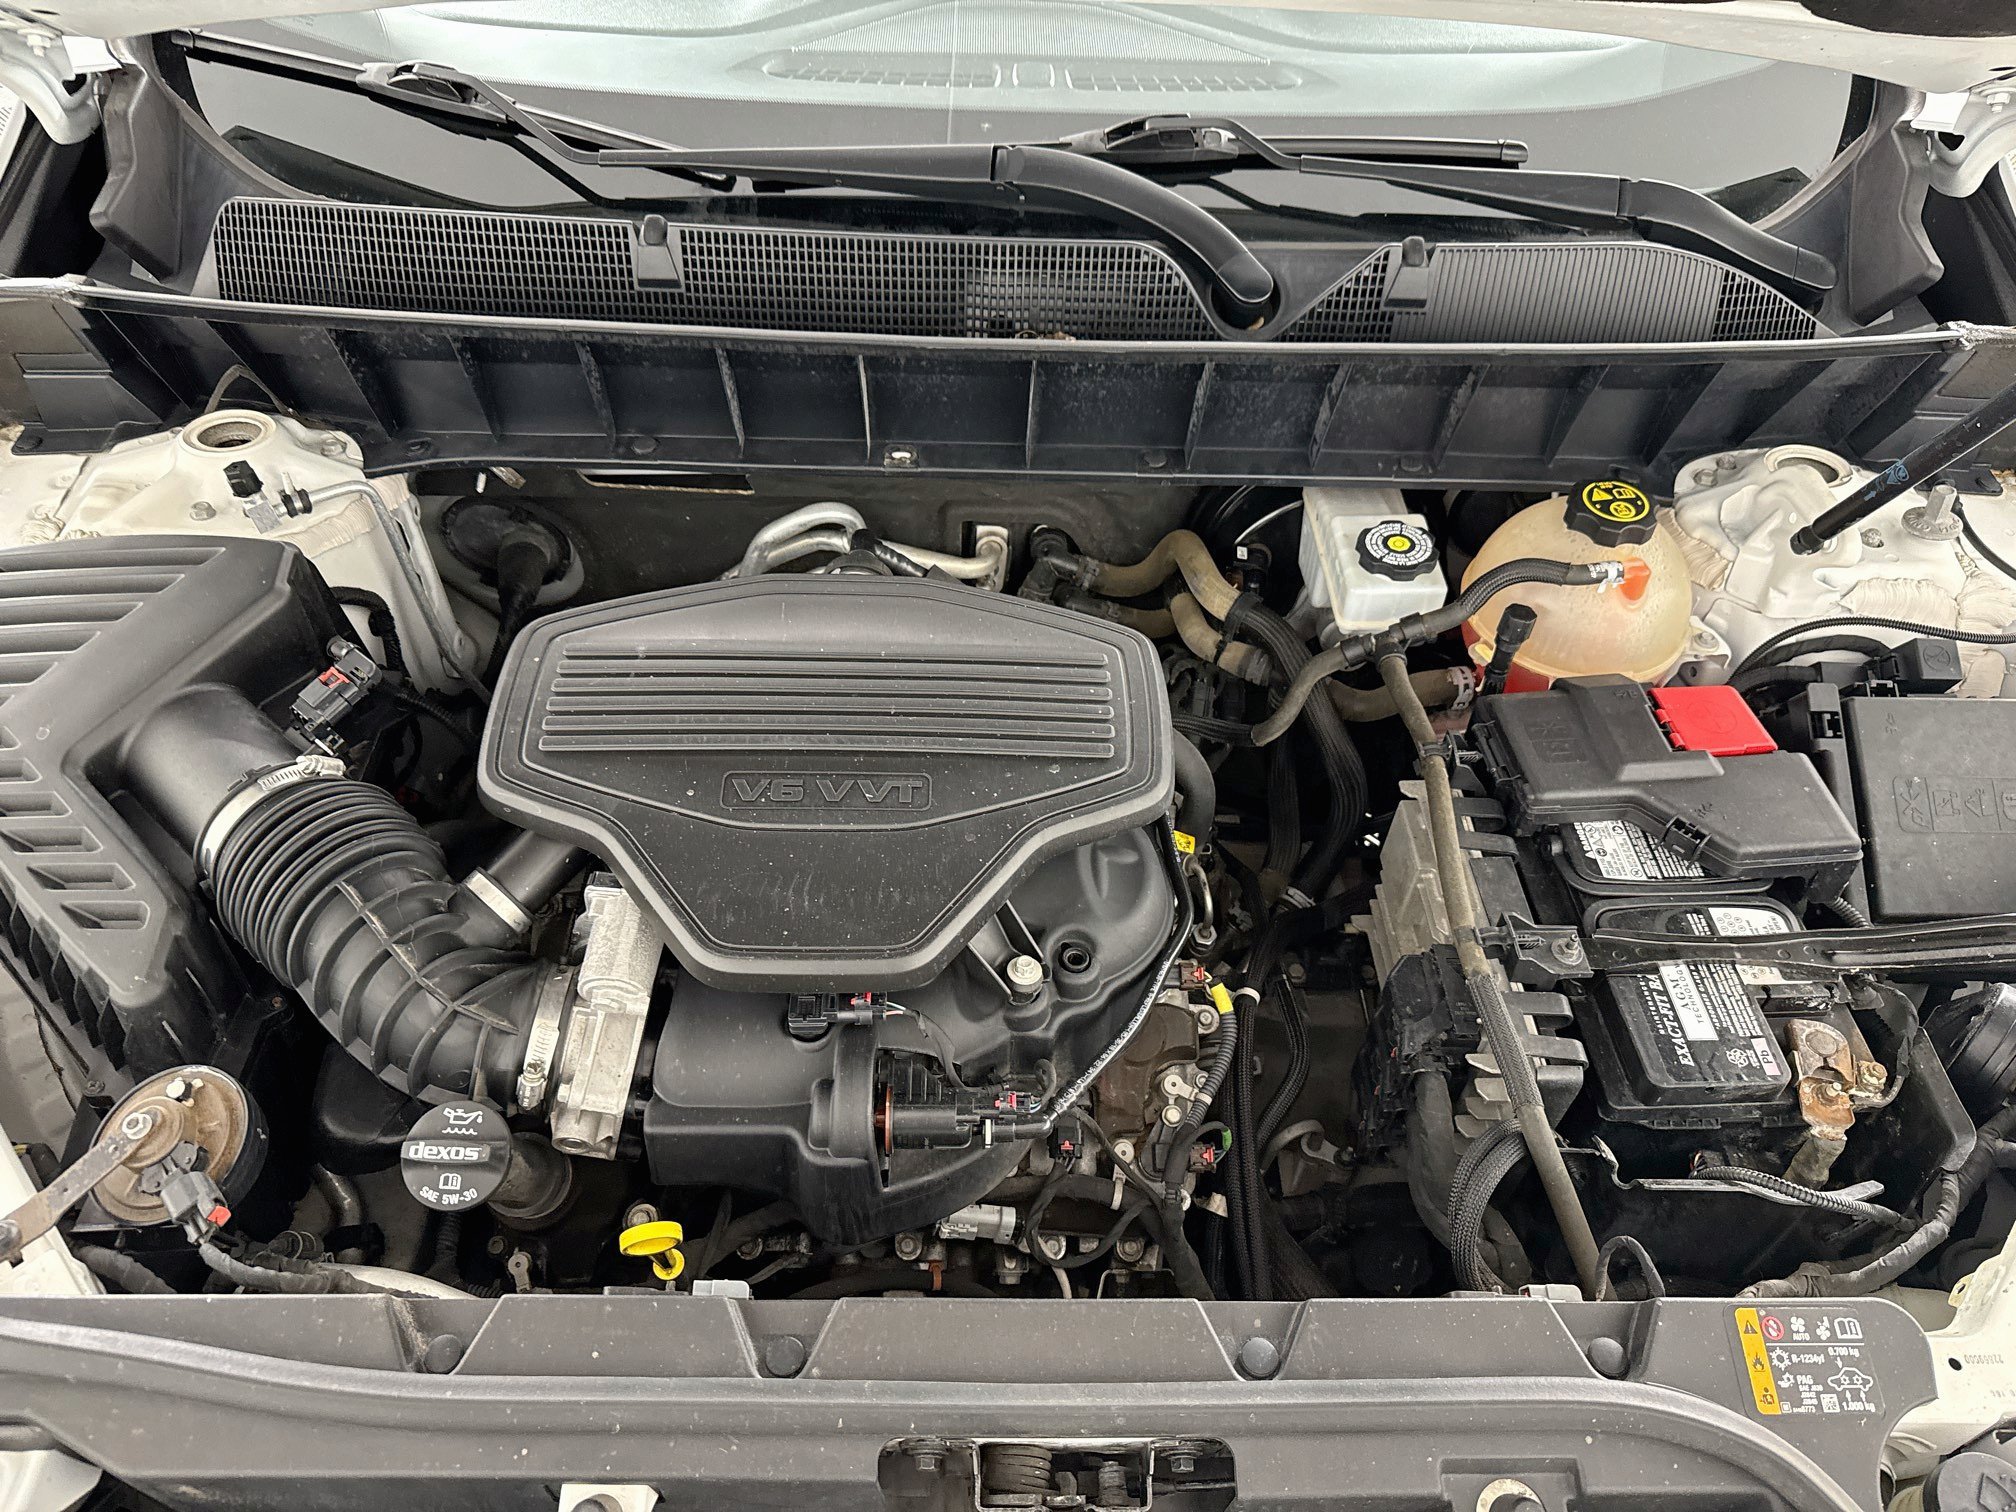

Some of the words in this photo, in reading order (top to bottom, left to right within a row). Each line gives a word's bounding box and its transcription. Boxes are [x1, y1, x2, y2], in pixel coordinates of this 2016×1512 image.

[731, 778, 804, 801] V6
[816, 779, 923, 802] VVT
[1653, 991, 1696, 1067] EXACT-FIT
[1762, 1050, 1773, 1064] Pb
[408, 1142, 483, 1160] dexos
[420, 1186, 440, 1203] SAE
[442, 1188, 478, 1205] 5W-30
[1792, 1333, 1810, 1341] AUTO
[1791, 1353, 1825, 1365] R-1234yf
[1828, 1347, 1848, 1356] 0.700
[1849, 1347, 1860, 1358] kg
[1796, 1375, 1814, 1385] PAG
[1842, 1402, 1865, 1411] 1.000
[1865, 1402, 1876, 1413] kg
